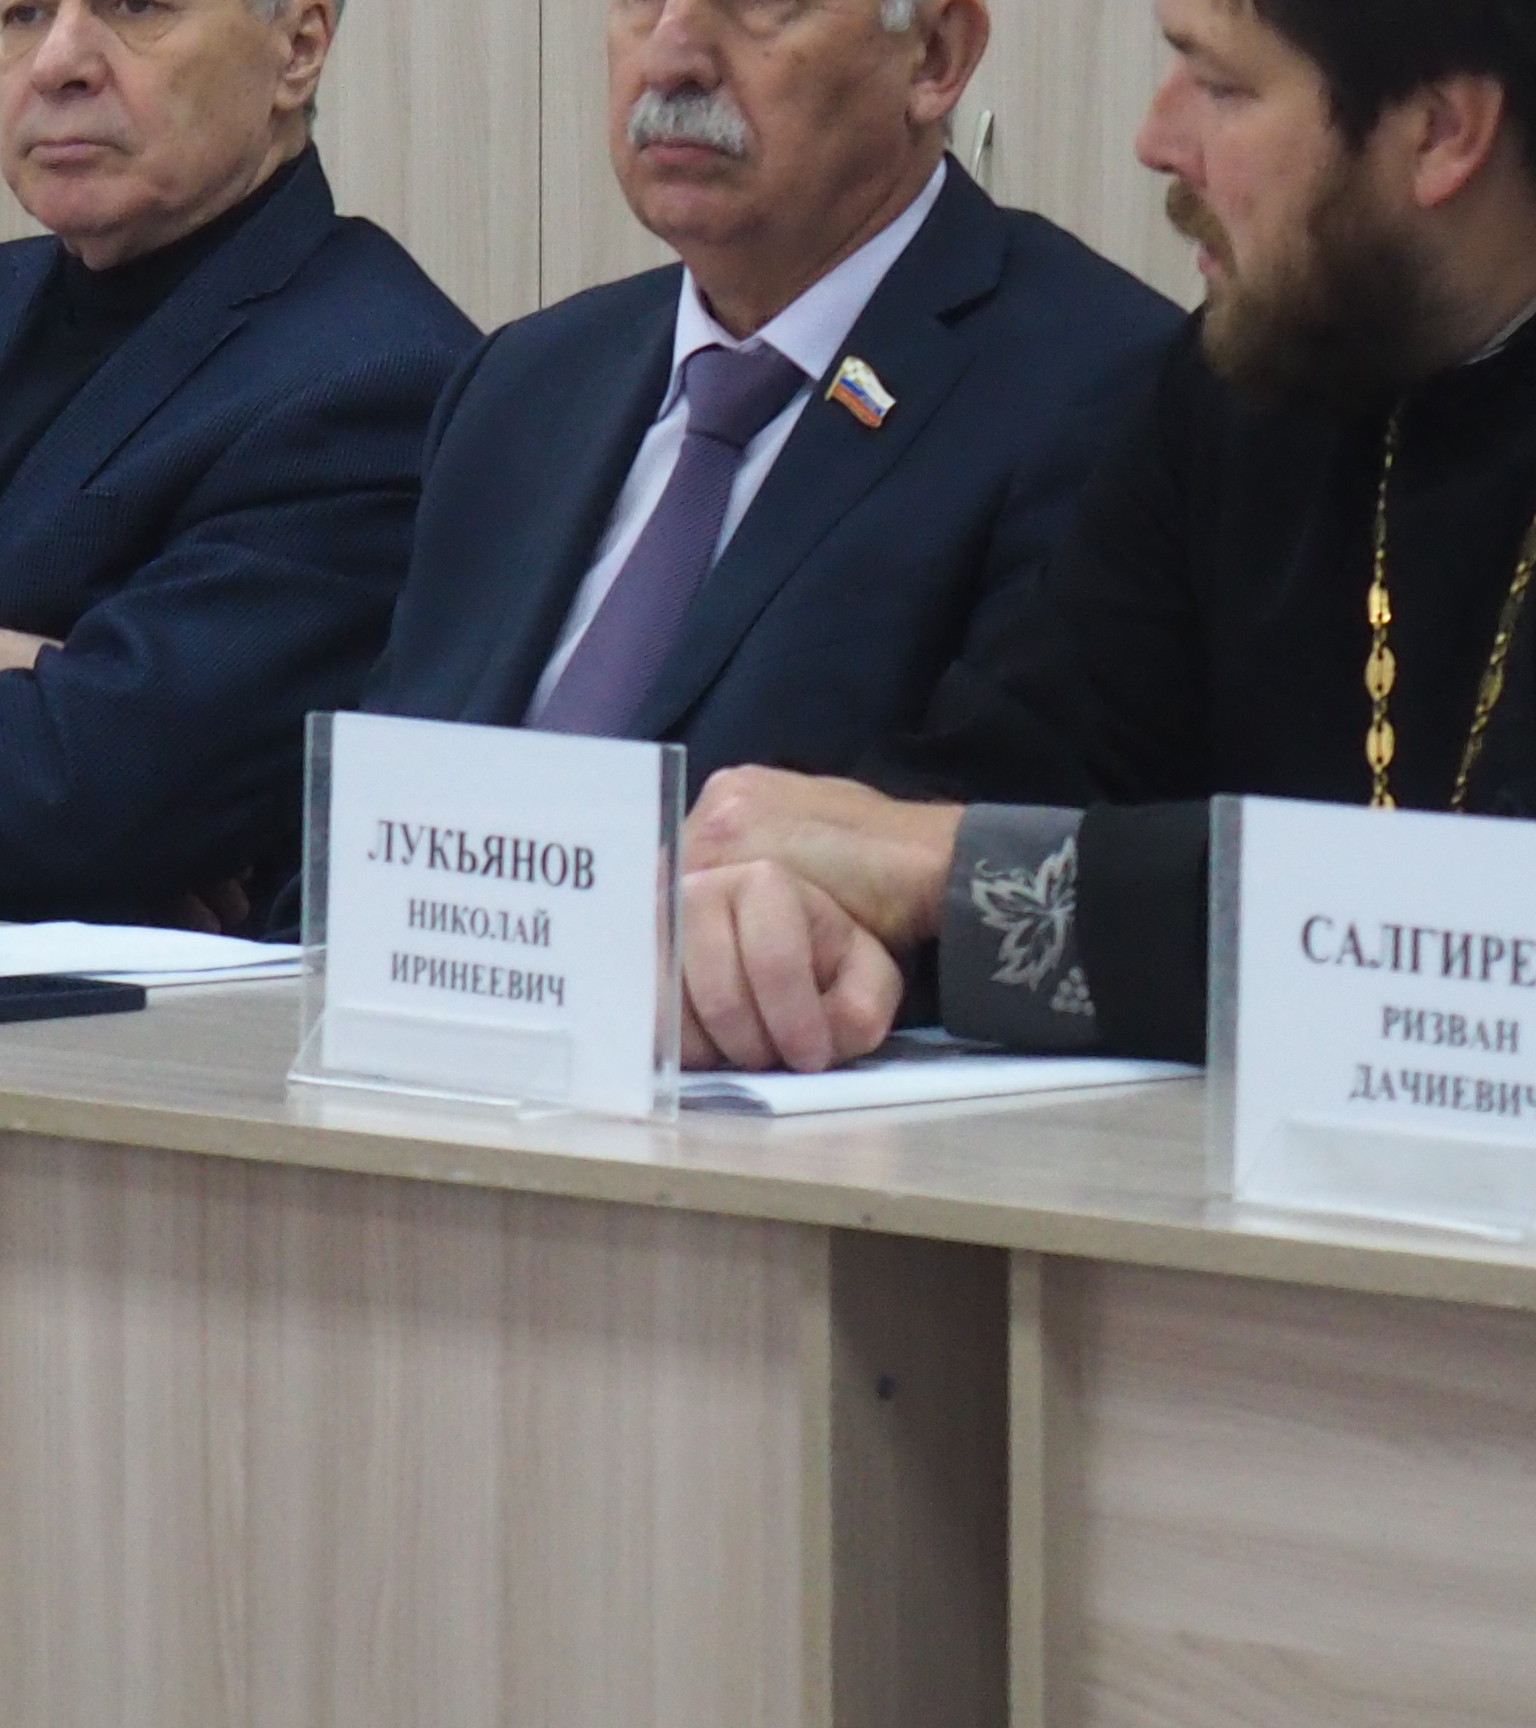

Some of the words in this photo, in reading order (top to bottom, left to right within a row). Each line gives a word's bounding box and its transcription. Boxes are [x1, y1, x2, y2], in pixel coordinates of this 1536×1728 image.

[368, 820, 596, 891] ЛУКЬЯНОВ
[408, 898, 552, 948] НИКОЛАЙ
[391, 952, 565, 1007] ИРИНЕЕВИЧ
[1381, 1005, 1520, 1054] РИЗВАН
